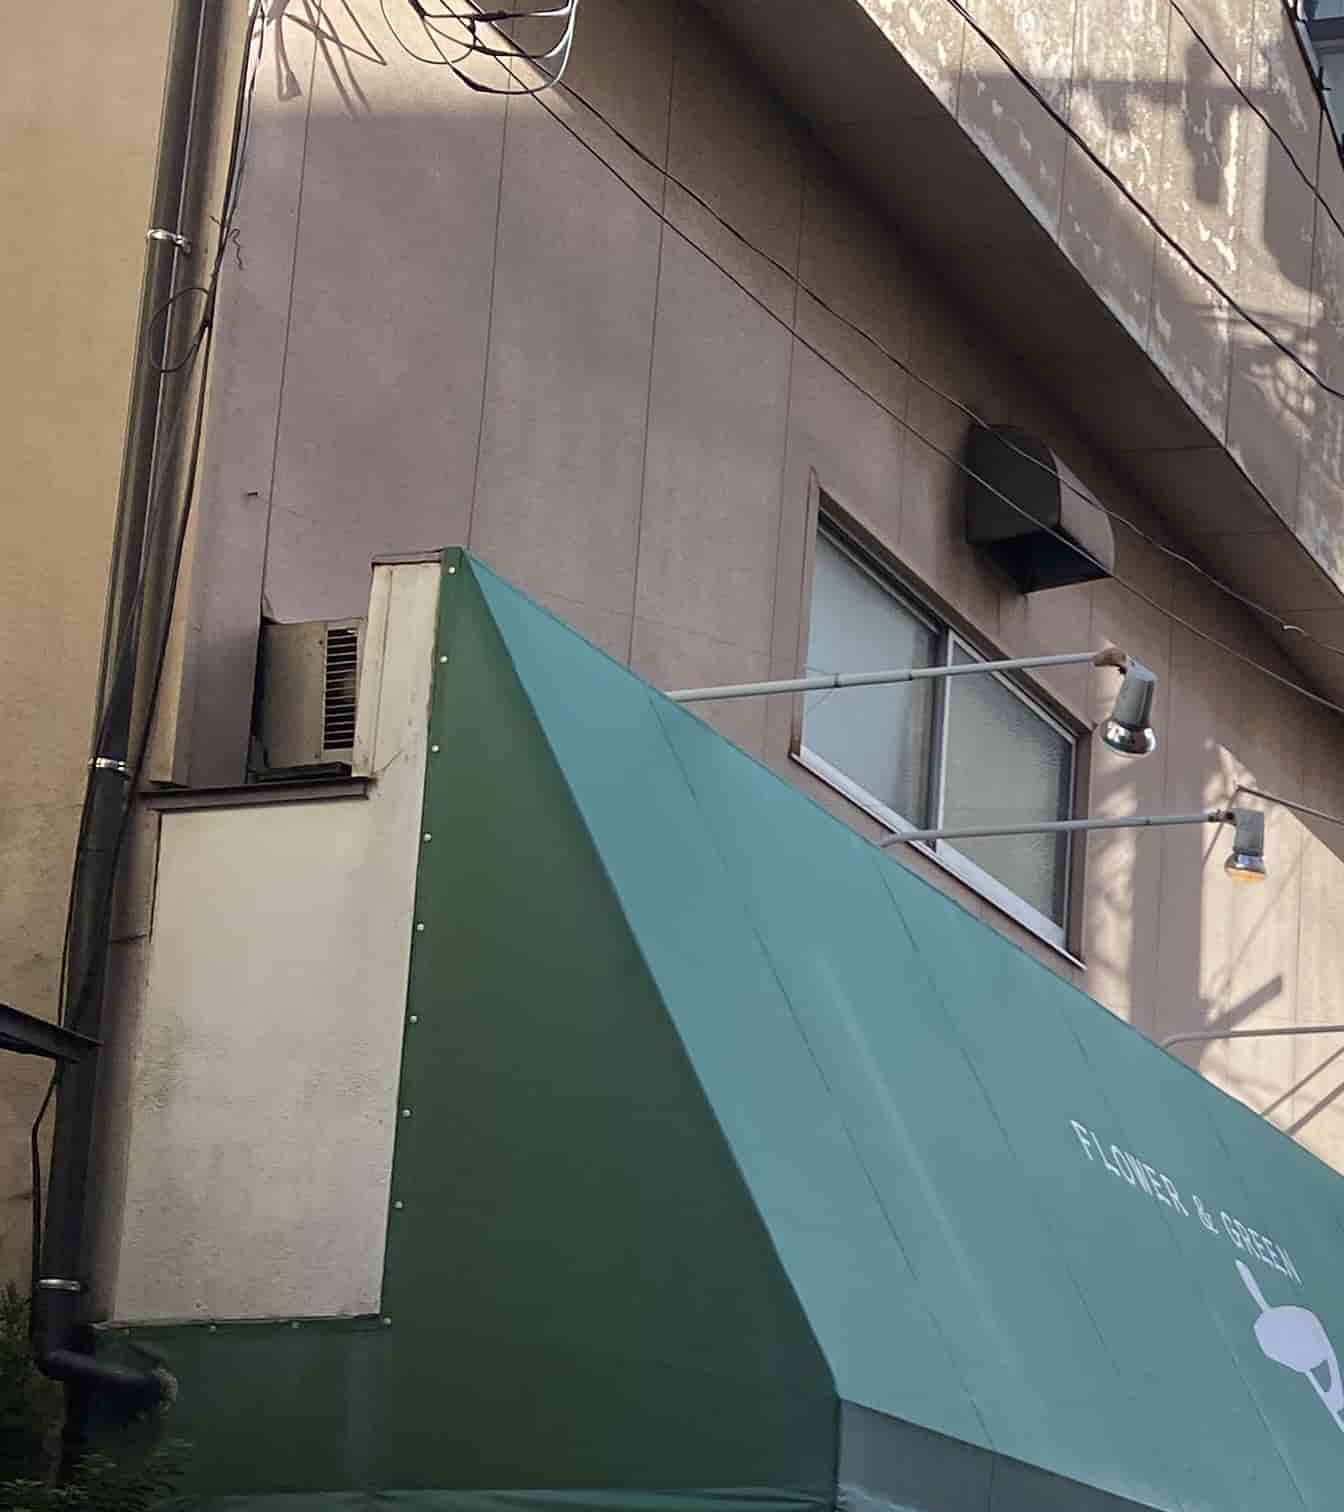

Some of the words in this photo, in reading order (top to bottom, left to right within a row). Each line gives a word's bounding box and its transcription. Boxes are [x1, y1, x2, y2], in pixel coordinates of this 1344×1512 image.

[1070, 1119, 1189, 1216] FLOWER
[1192, 1194, 1219, 1234] &
[1220, 1210, 1302, 1284] GREEN
